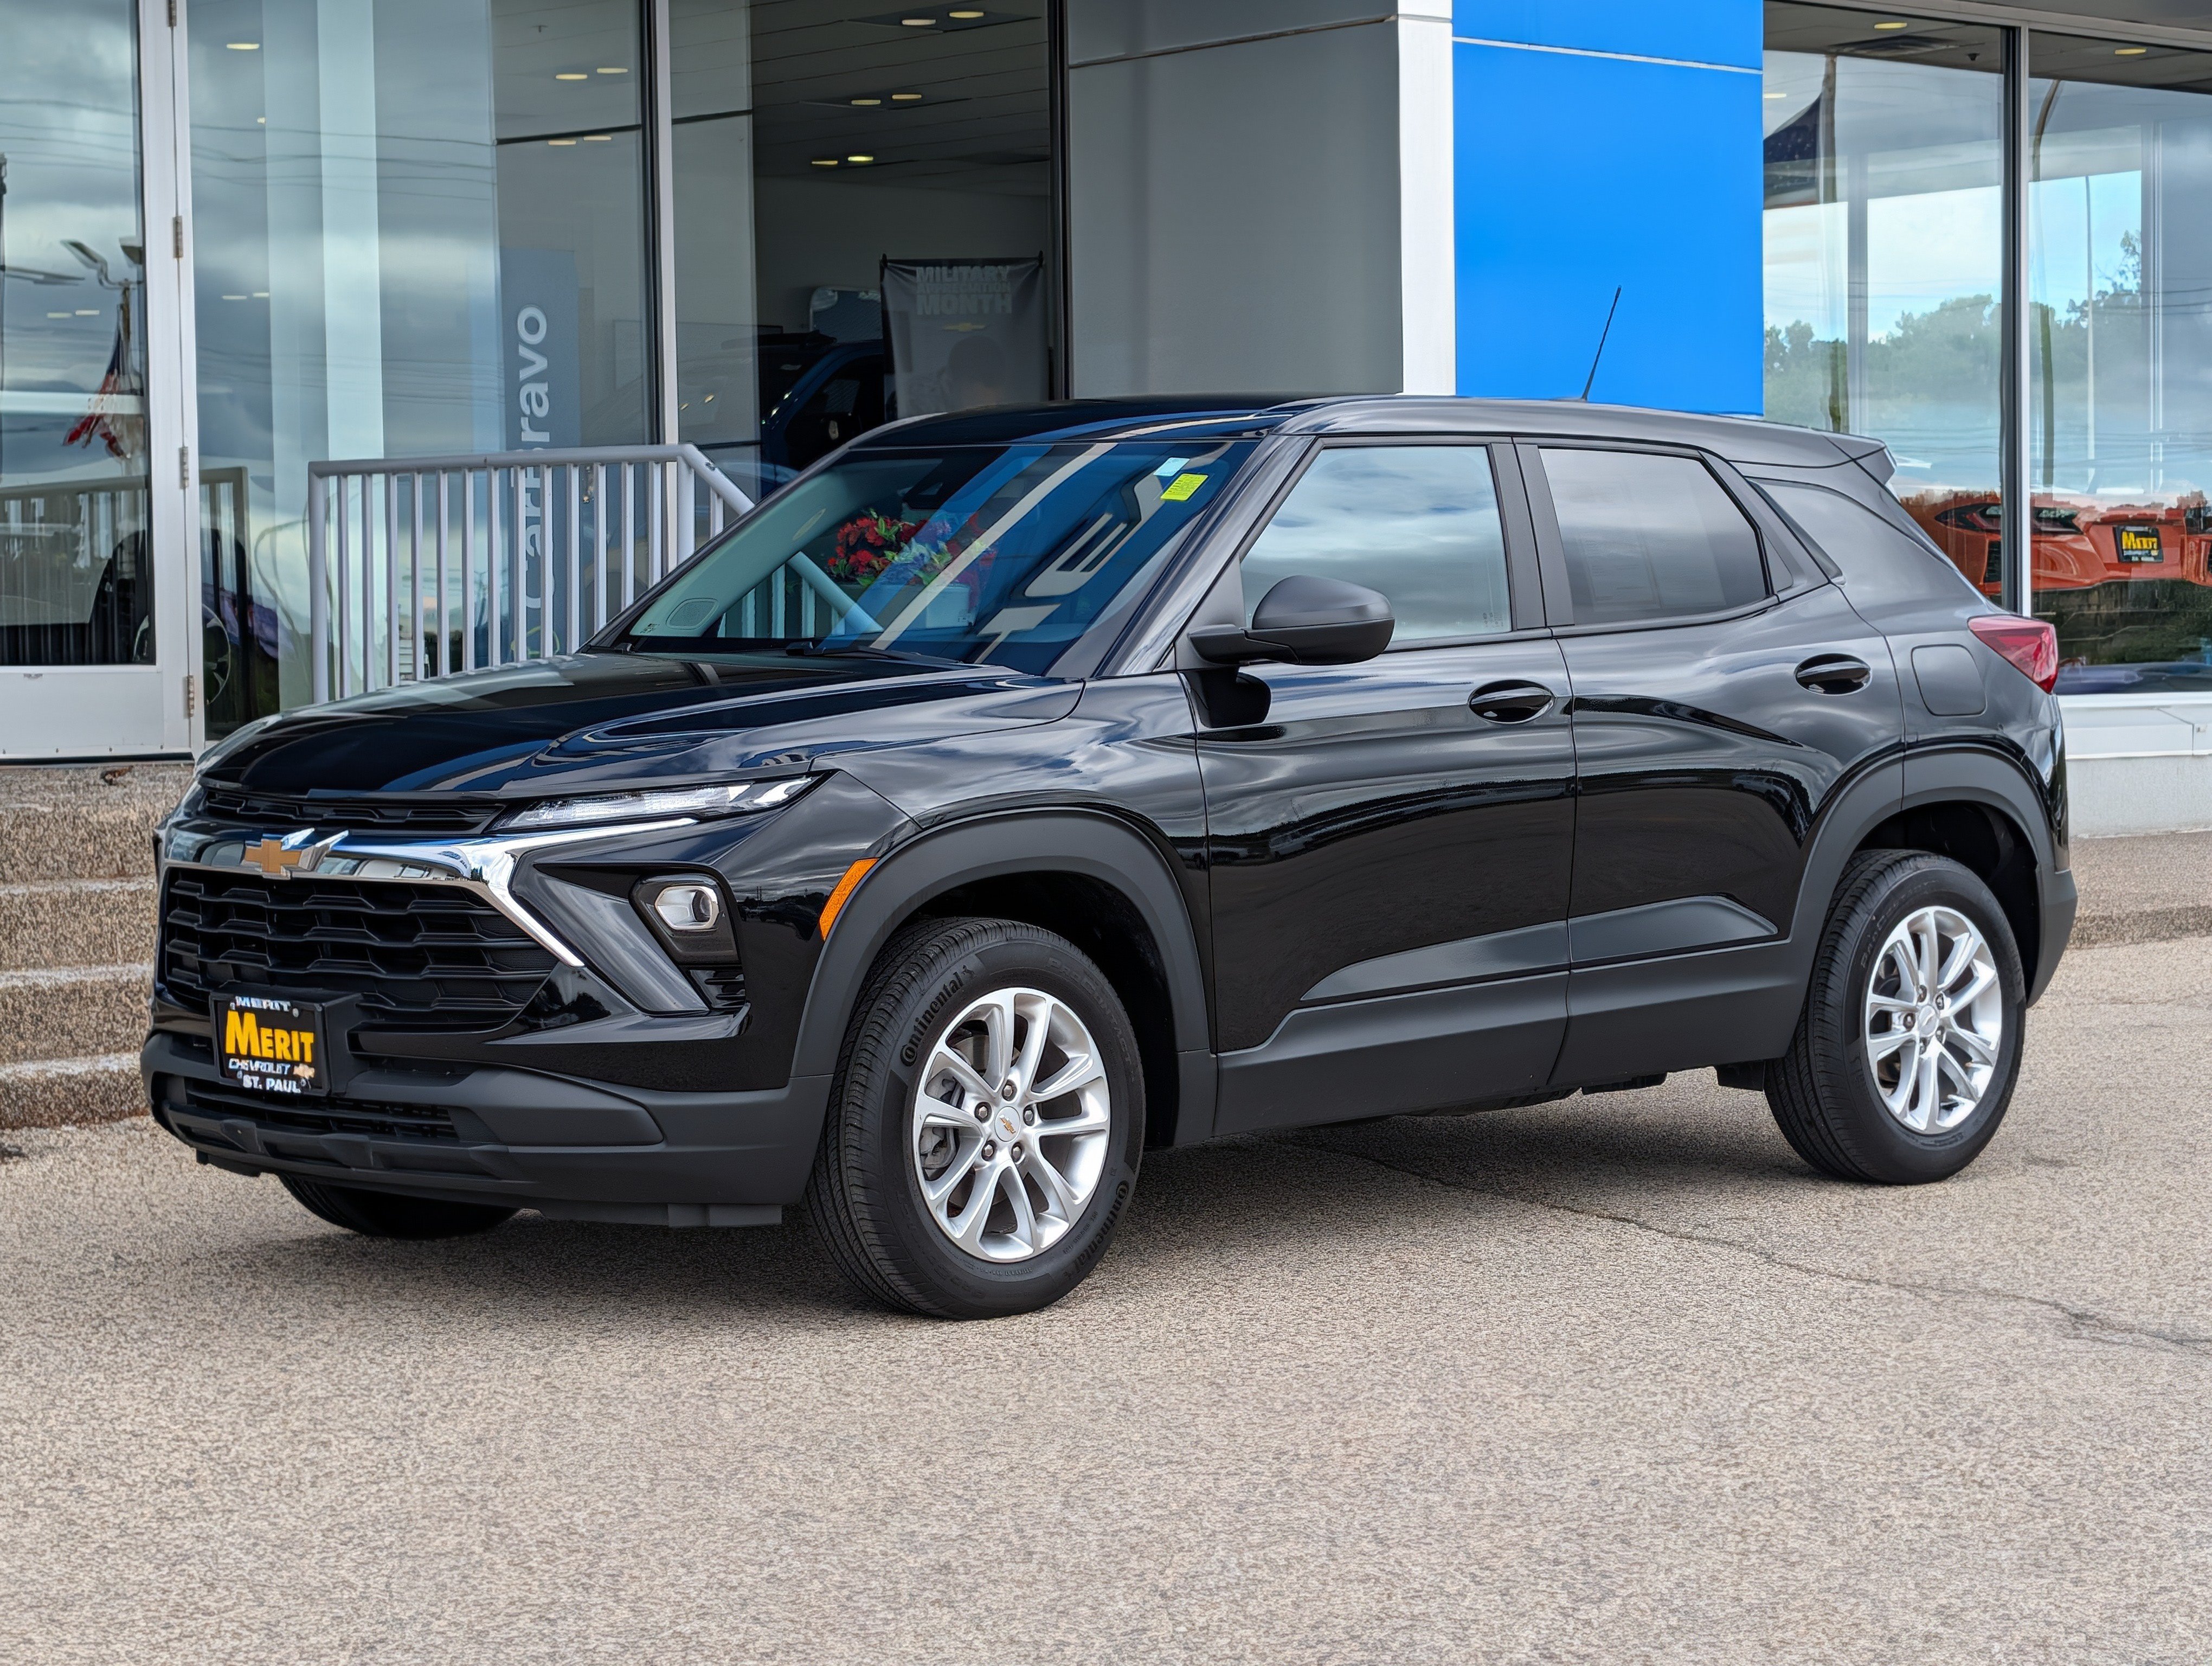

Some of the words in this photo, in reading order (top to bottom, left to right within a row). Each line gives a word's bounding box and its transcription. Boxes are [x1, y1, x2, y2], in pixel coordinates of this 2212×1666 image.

[916, 266, 1009, 282] MILITARY
[916, 294, 1012, 315] MONTH
[226, 1010, 314, 1062] MERIT
[900, 971, 963, 1066] Continental
[243, 1074, 263, 1090] ST.
[266, 1078, 301, 1093] PAUL
[1074, 1180, 1129, 1273] Continental
